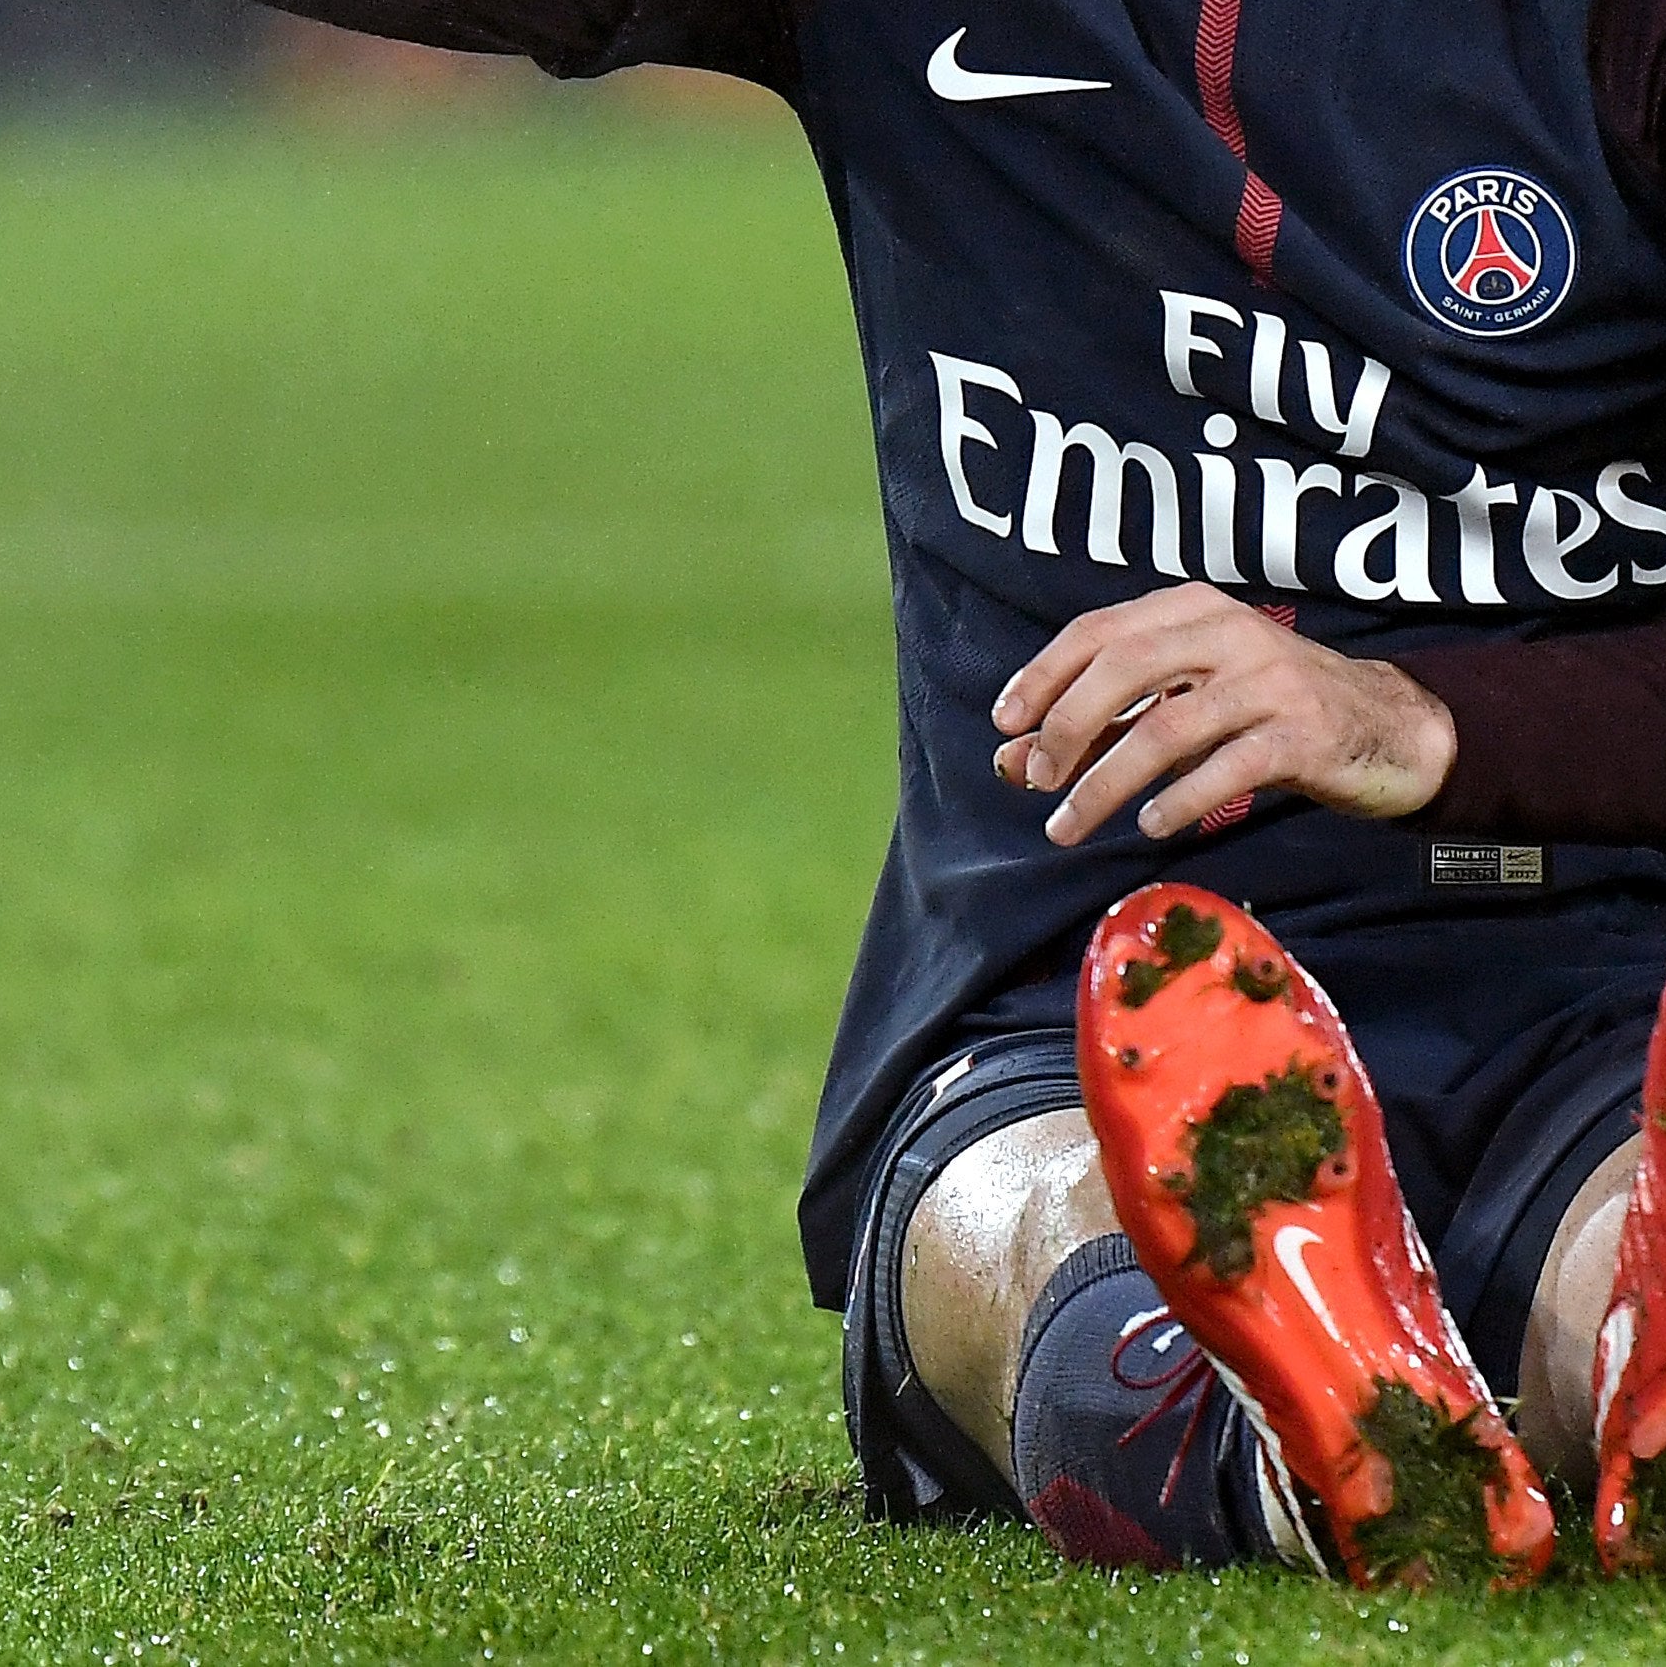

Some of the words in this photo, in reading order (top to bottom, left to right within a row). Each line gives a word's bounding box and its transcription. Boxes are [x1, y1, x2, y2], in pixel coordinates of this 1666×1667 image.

[1428, 179, 1539, 224] PARIS
[1159, 289, 1392, 457] Fly
[1436, 849, 1498, 860] AUTHENTIC
